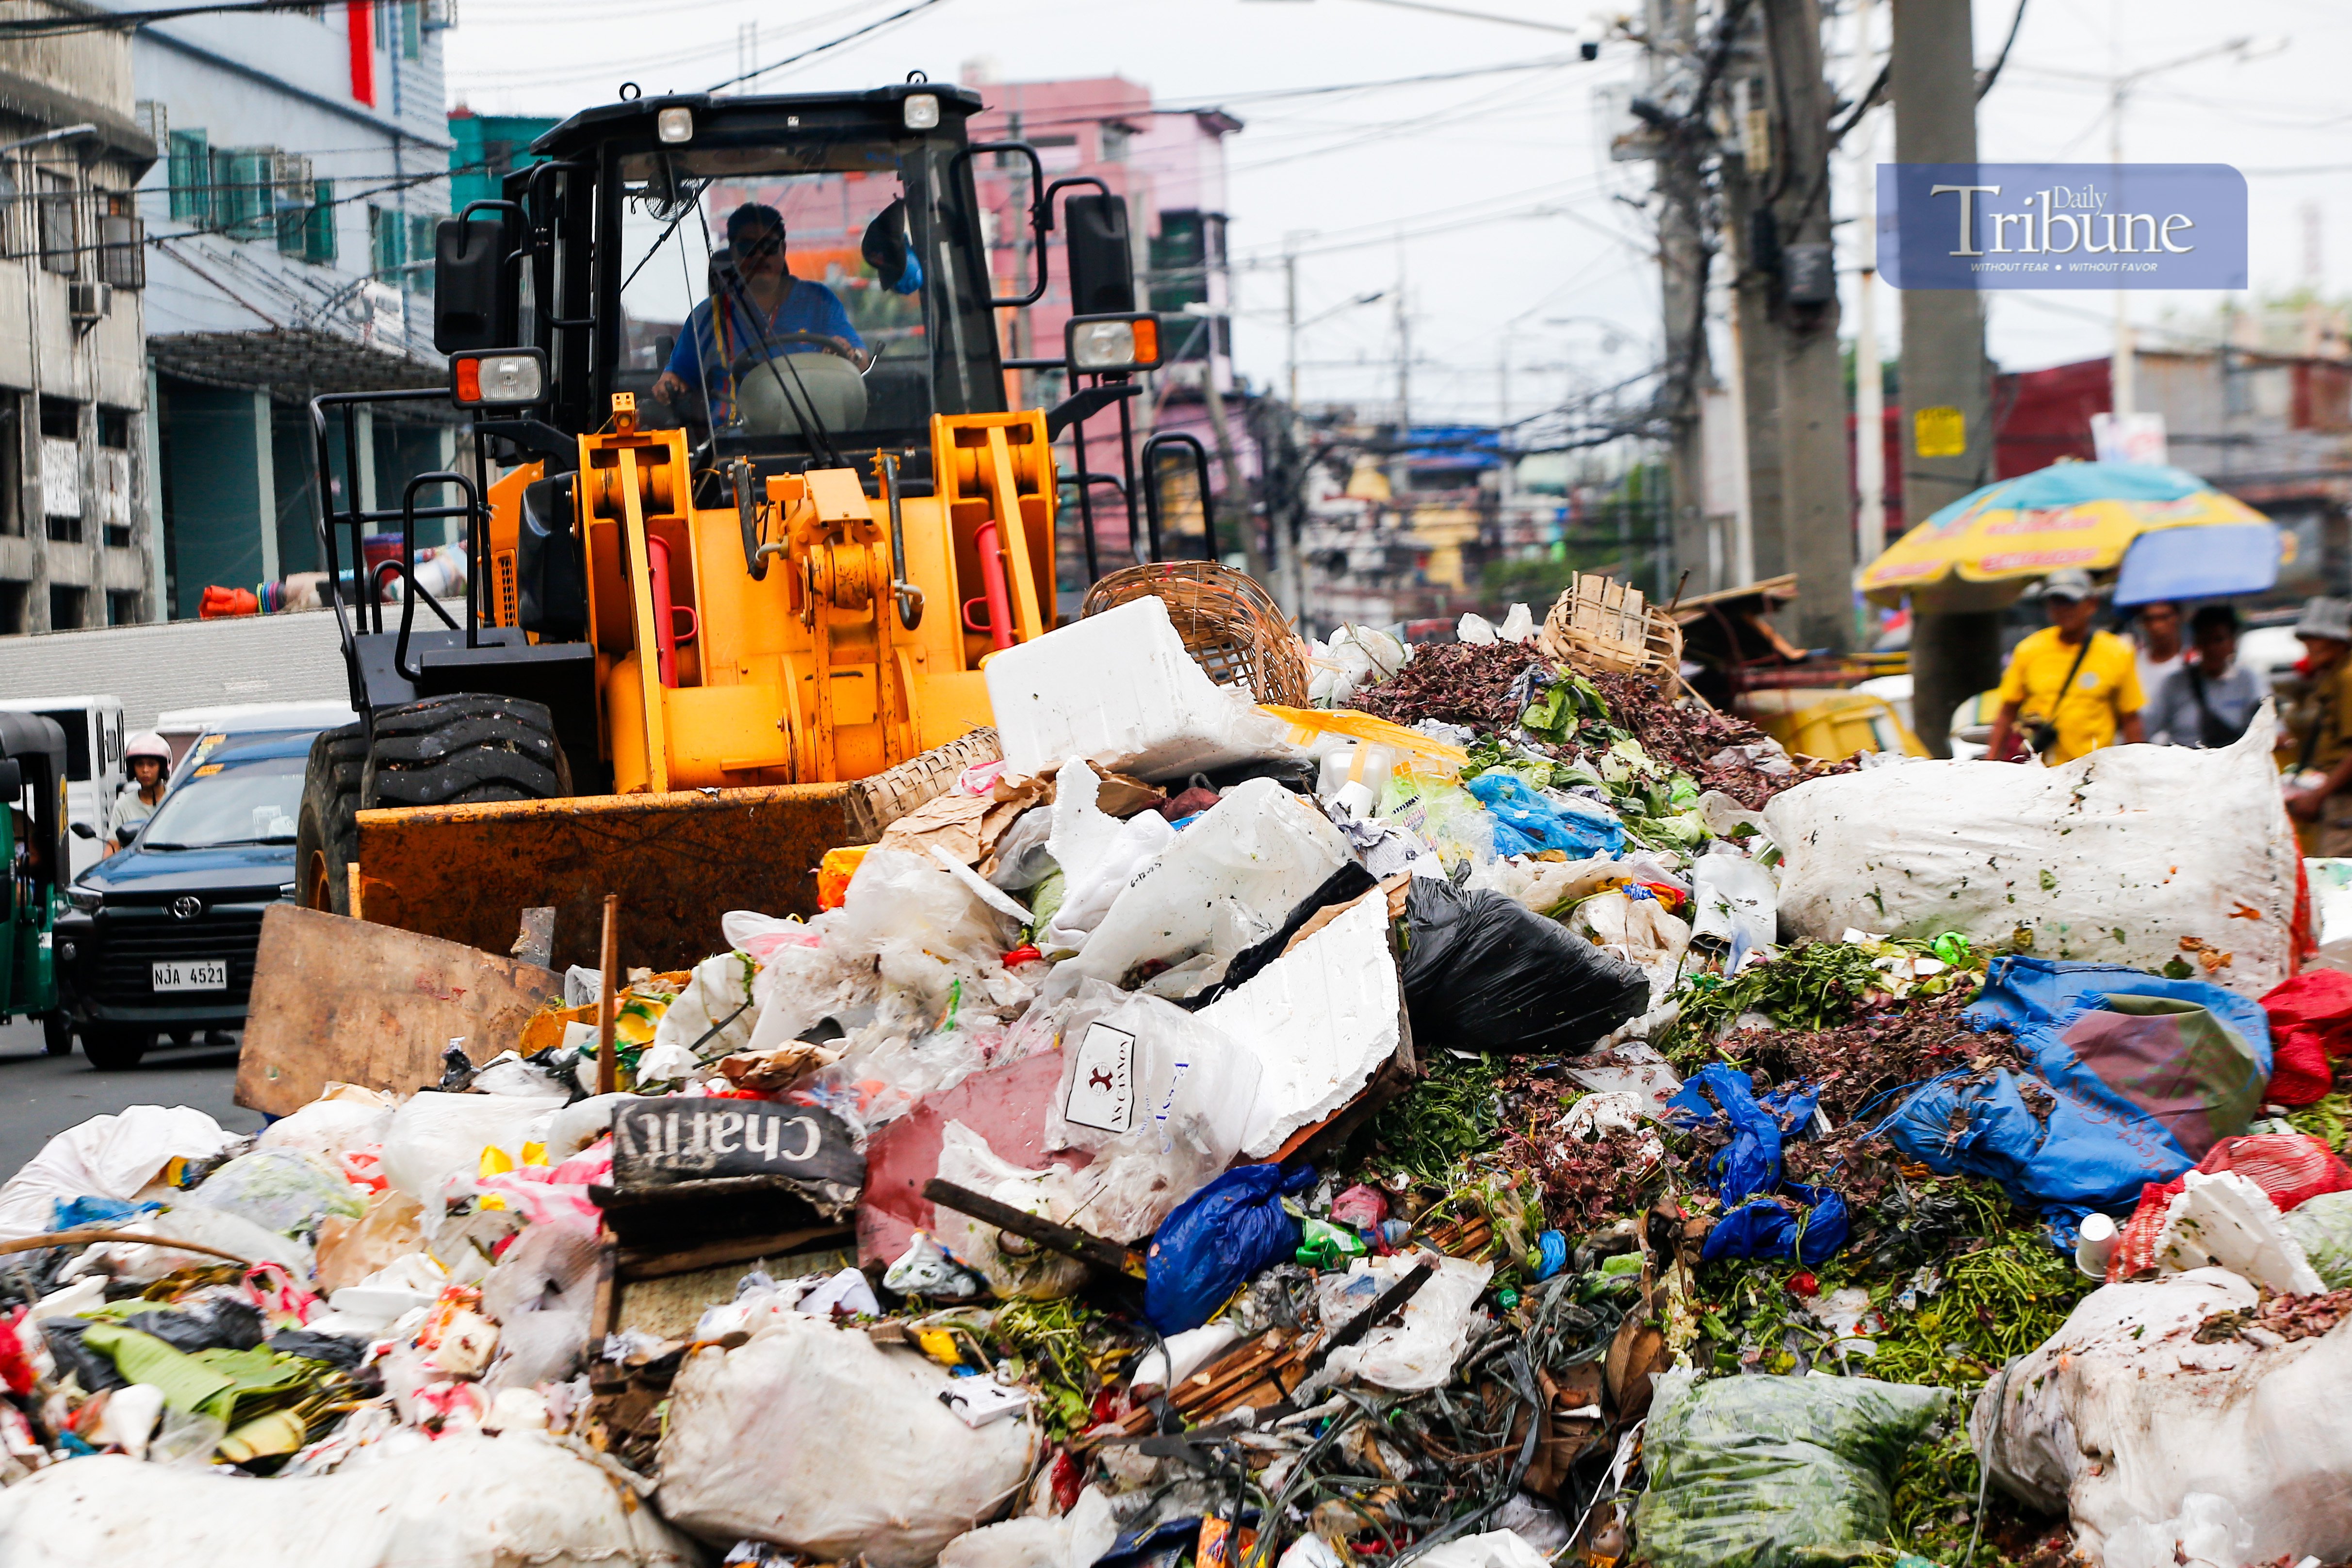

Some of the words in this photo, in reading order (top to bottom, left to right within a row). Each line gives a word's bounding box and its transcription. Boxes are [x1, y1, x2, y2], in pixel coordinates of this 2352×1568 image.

[155, 968, 180, 985] NJA
[190, 967, 224, 984] 4521
[1111, 1105, 1122, 1125] XS
[1117, 1038, 1129, 1102] CANNON
